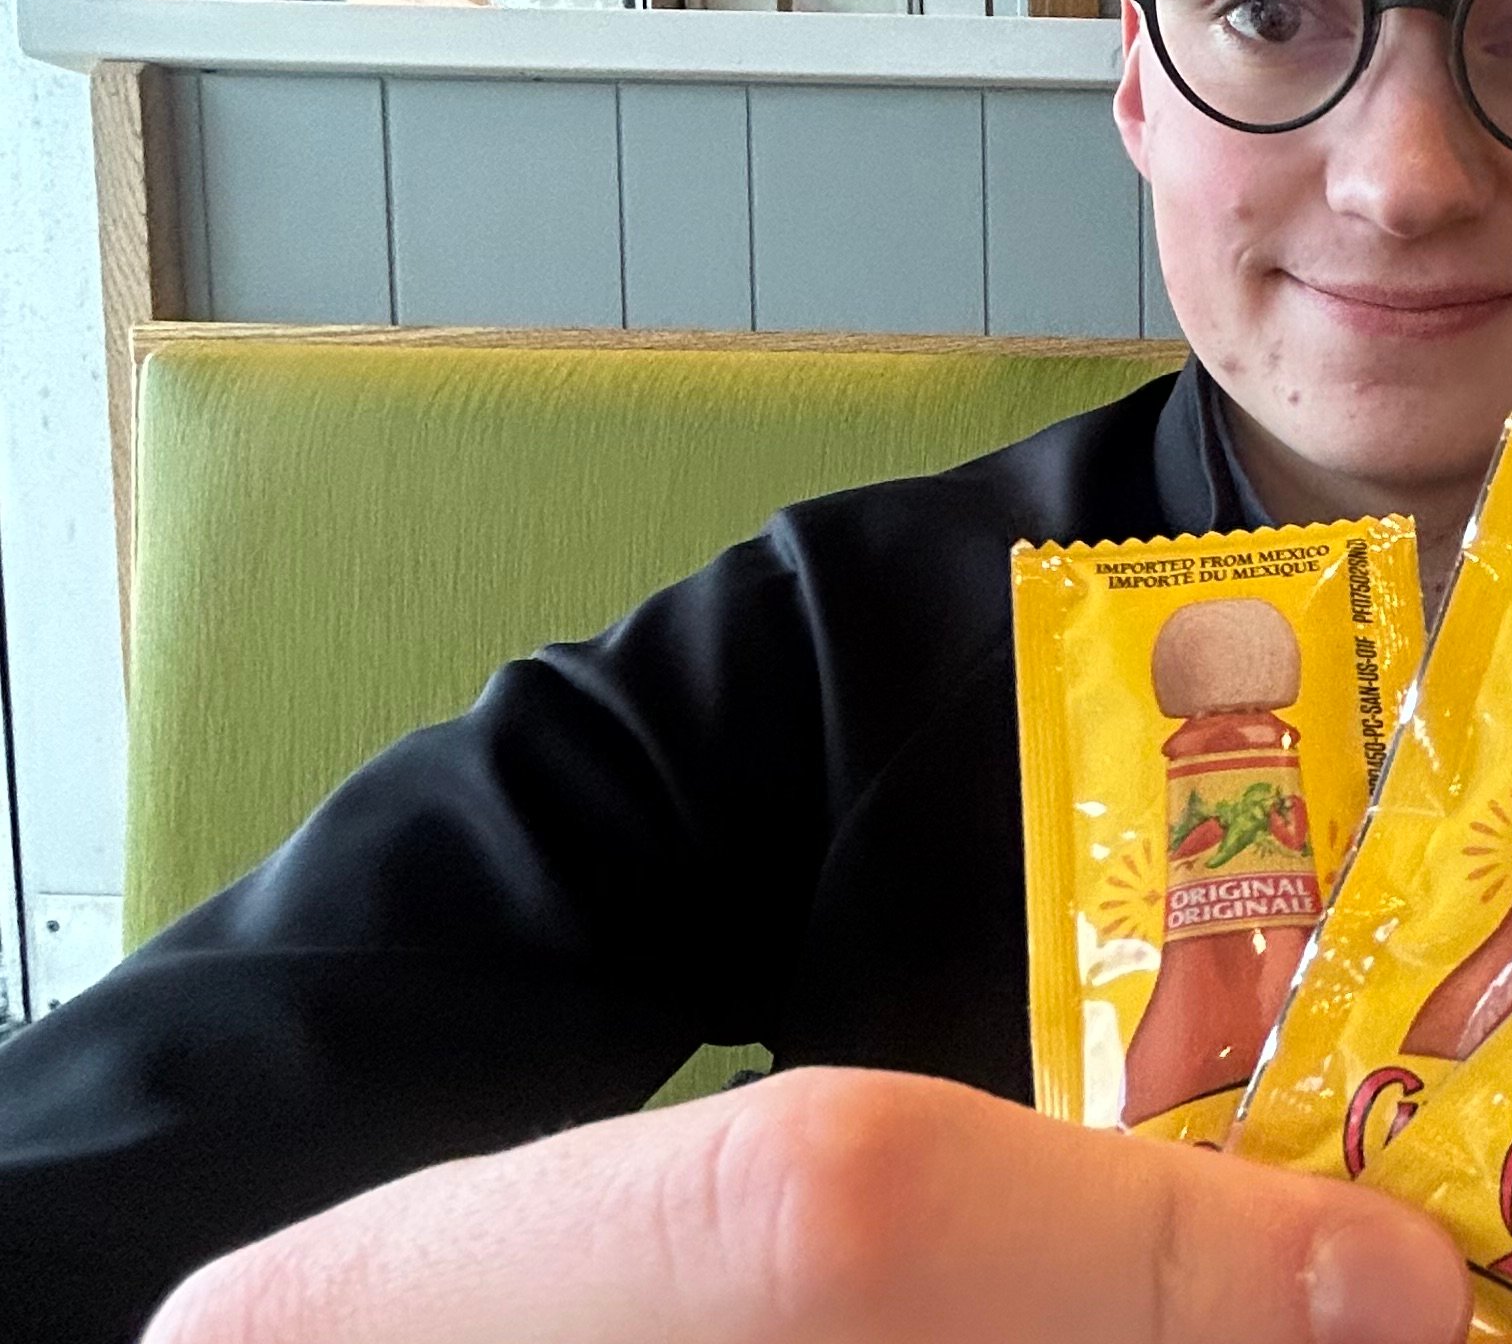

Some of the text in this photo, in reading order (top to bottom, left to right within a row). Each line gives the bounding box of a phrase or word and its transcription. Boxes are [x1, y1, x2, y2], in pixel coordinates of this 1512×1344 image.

[1096, 545, 1330, 576] IMPORTED FROM MEXICO
[1108, 560, 1321, 590] IMPORTÉ DU MEXIQUE
[1169, 878, 1310, 910] ORIGINAL
[1166, 896, 1318, 929] ORIGINALE
